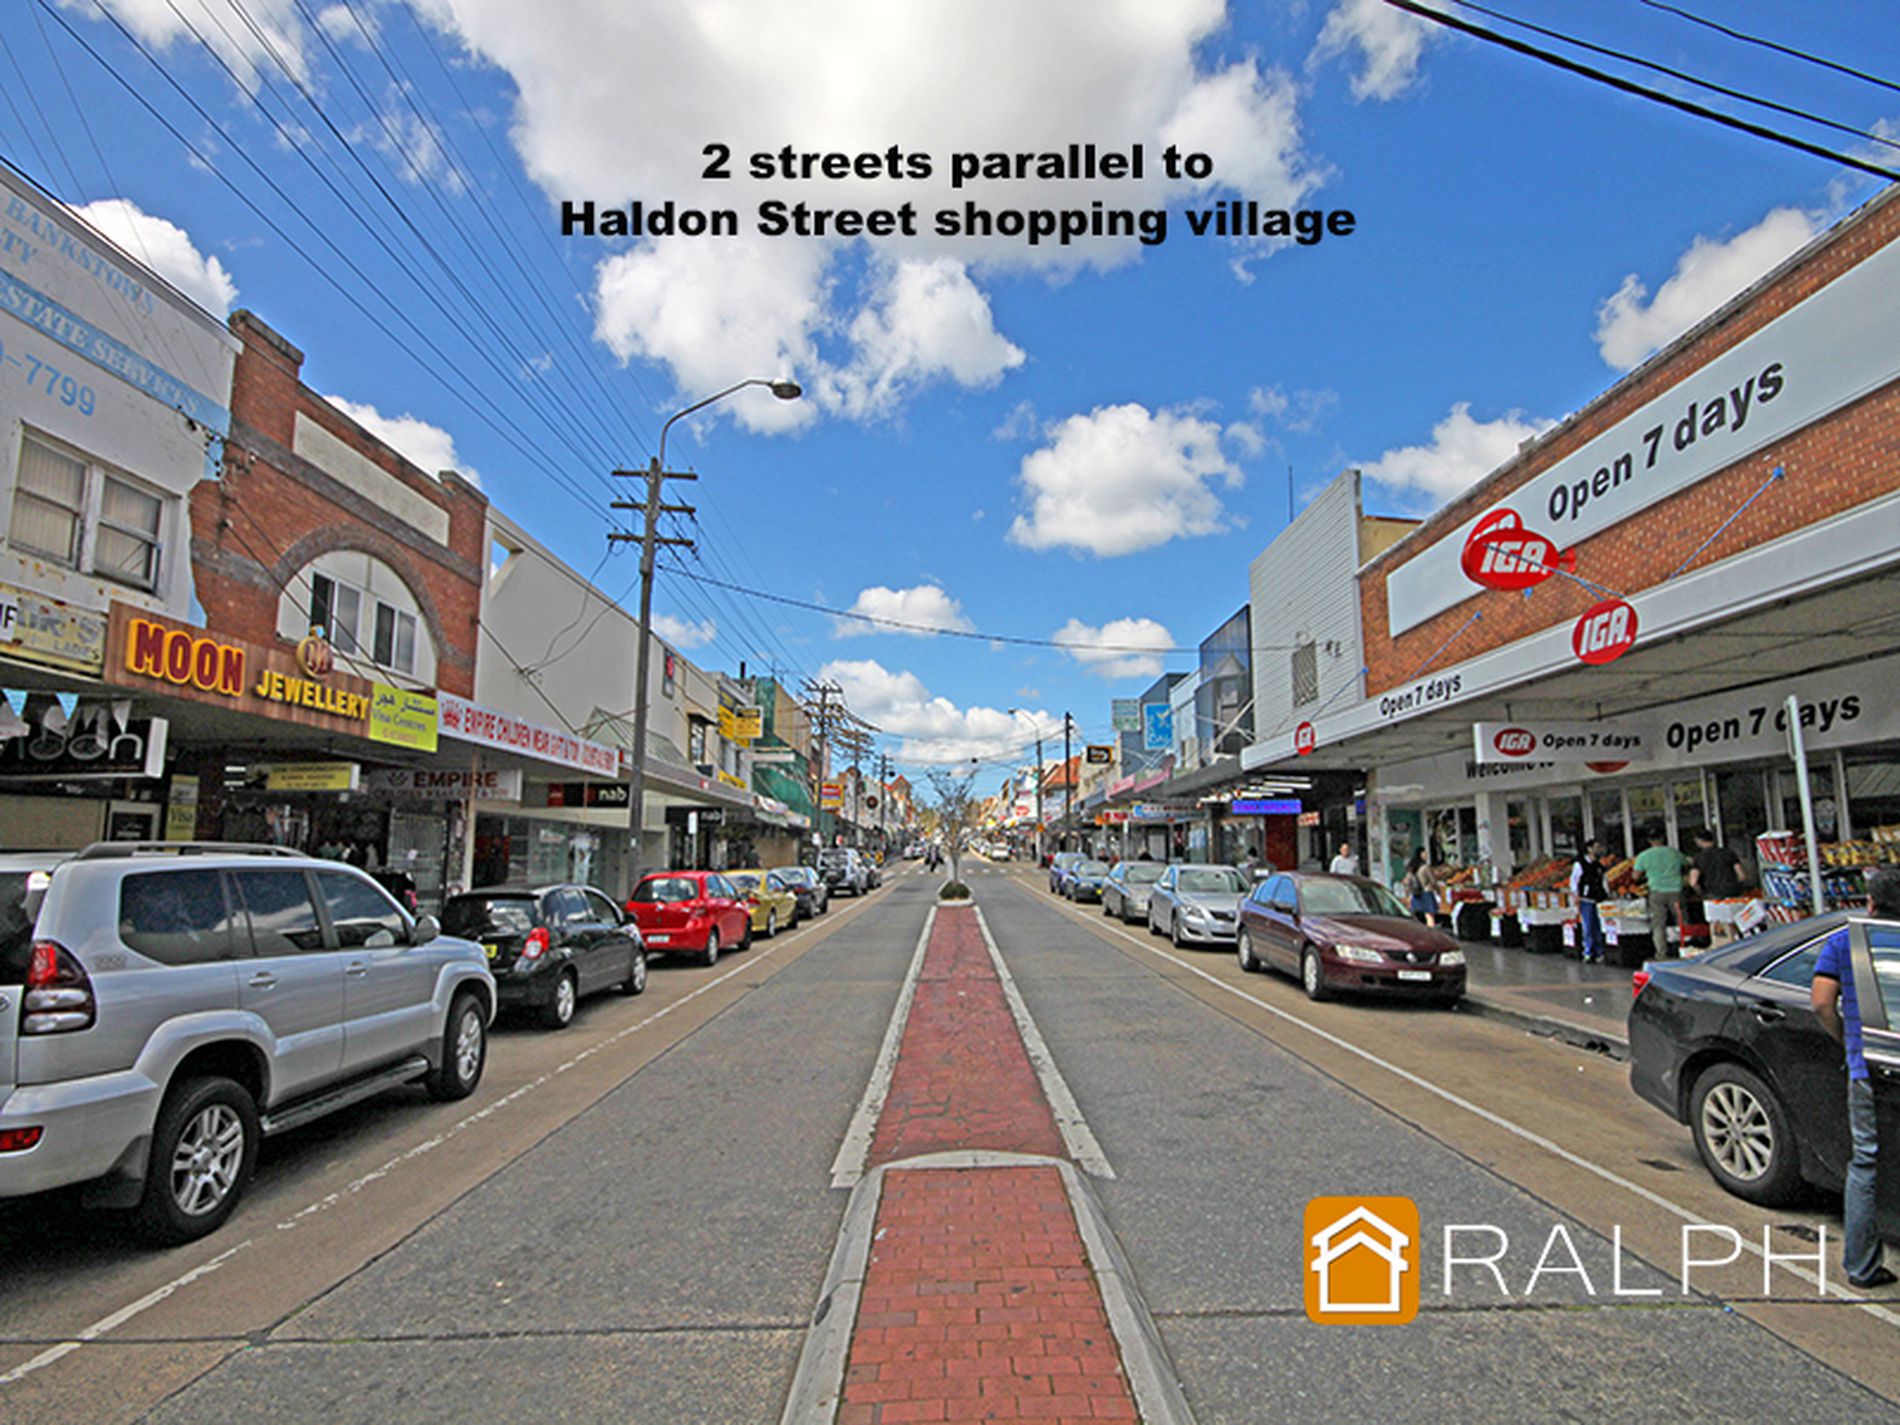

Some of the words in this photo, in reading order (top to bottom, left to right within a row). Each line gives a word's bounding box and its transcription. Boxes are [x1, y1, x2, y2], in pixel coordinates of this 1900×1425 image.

[0, 229, 37, 264] TY
[0, 338, 96, 417] -7799
[1549, 452, 1633, 522] Open
[1643, 424, 1664, 469] 7
[1674, 362, 1784, 451] days
[1480, 541, 1548, 575] IGA
[1579, 605, 1631, 656] IGA
[126, 618, 246, 698] MOON
[256, 670, 370, 721] JEWELLERY
[1380, 697, 1413, 719] Open
[1416, 685, 1423, 706] 7
[1426, 674, 1461, 701] days
[1499, 733, 1532, 750] IGA
[1542, 734, 1586, 749] Open
[1589, 734, 1599, 745] 7
[1602, 733, 1642, 749] days
[1667, 717, 1740, 753] Open
[1749, 707, 1767, 736] 7
[414, 771, 498, 788] EMPIRE
